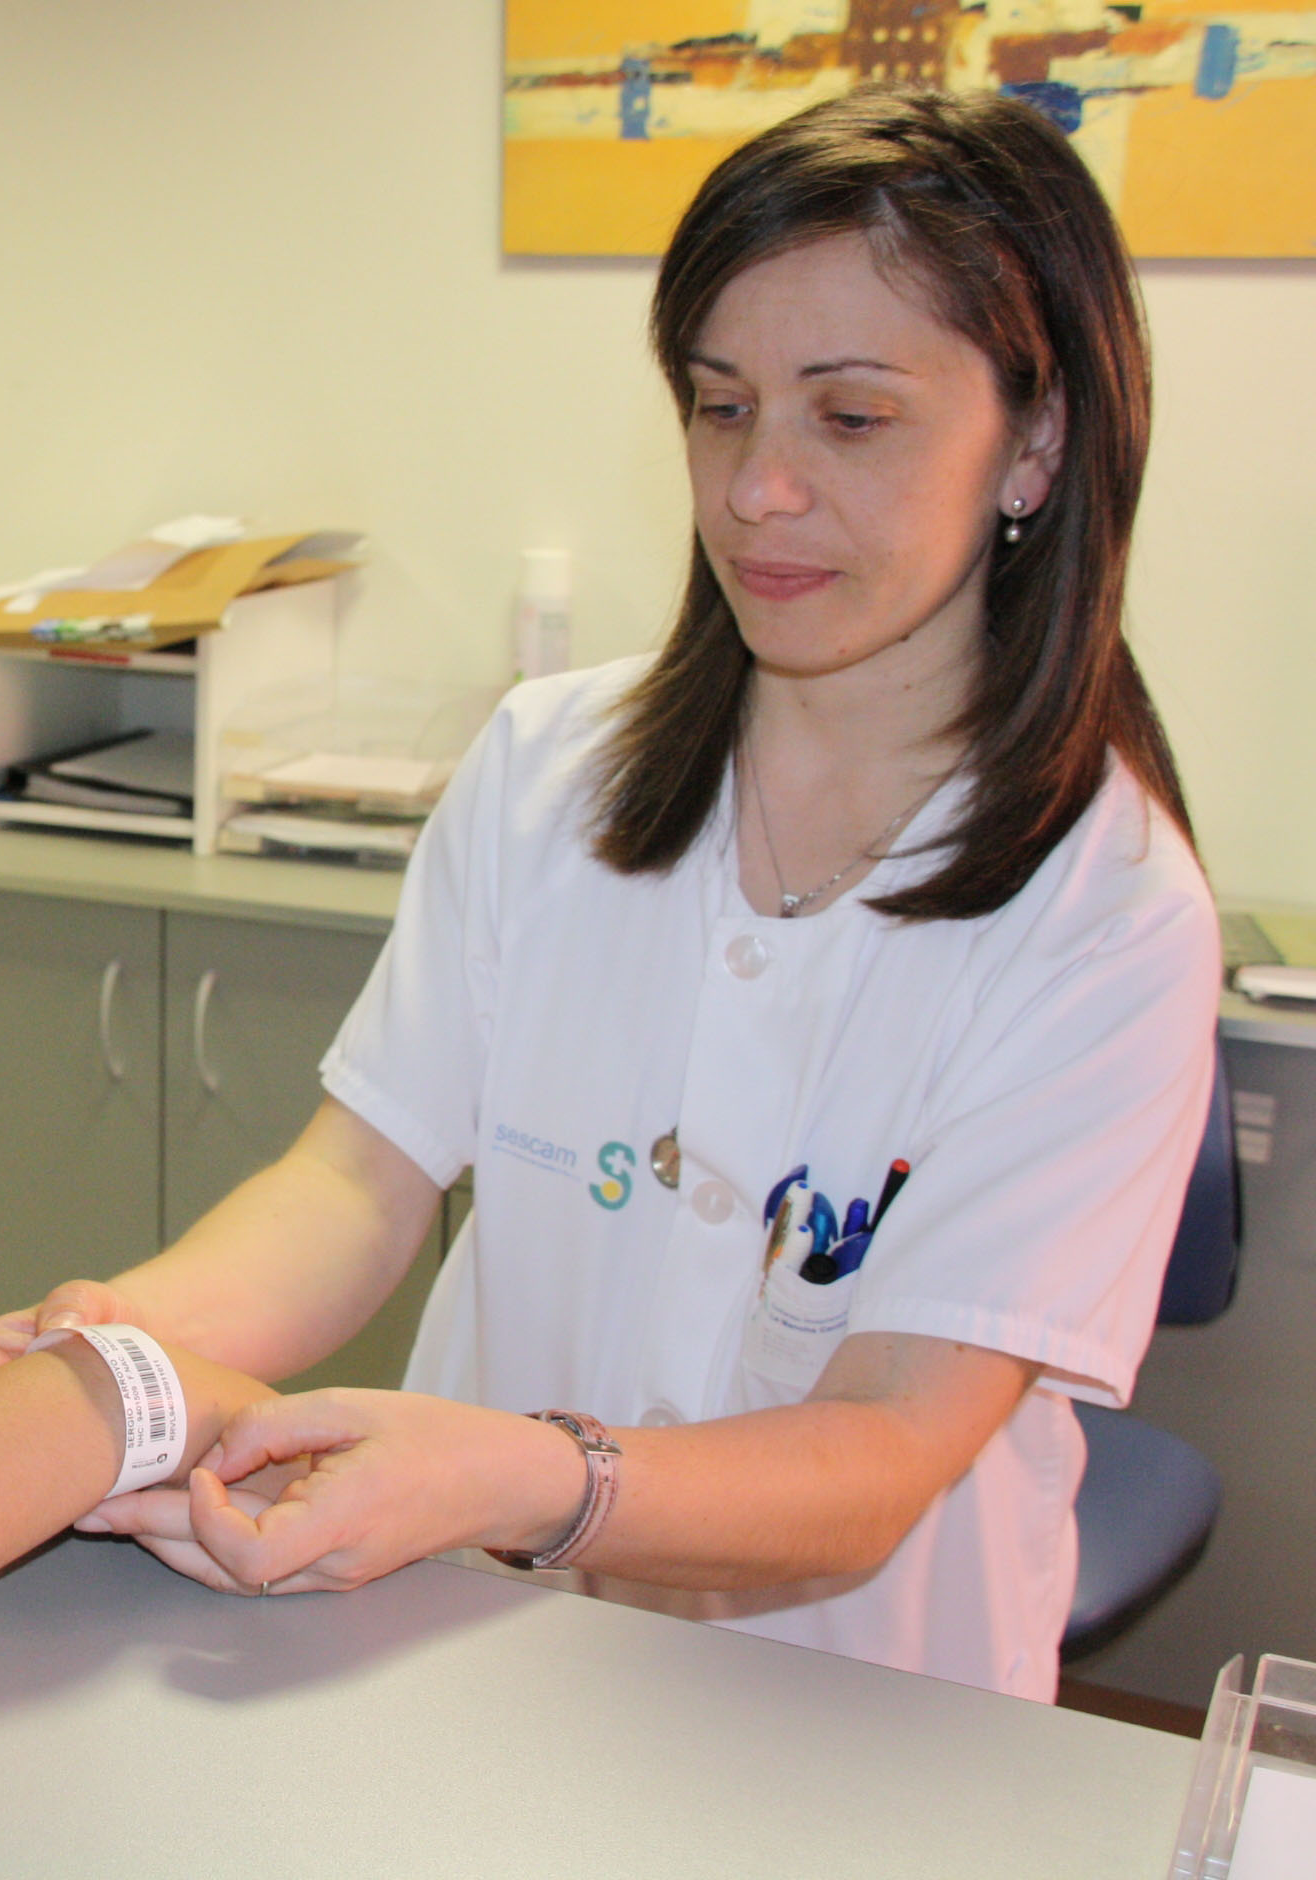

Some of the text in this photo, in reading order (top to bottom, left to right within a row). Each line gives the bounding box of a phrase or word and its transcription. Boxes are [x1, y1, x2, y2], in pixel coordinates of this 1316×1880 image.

[493, 1122, 578, 1168] sescam
[110, 1359, 132, 1400] ARROYO
[126, 1408, 135, 1449] SERGIO
